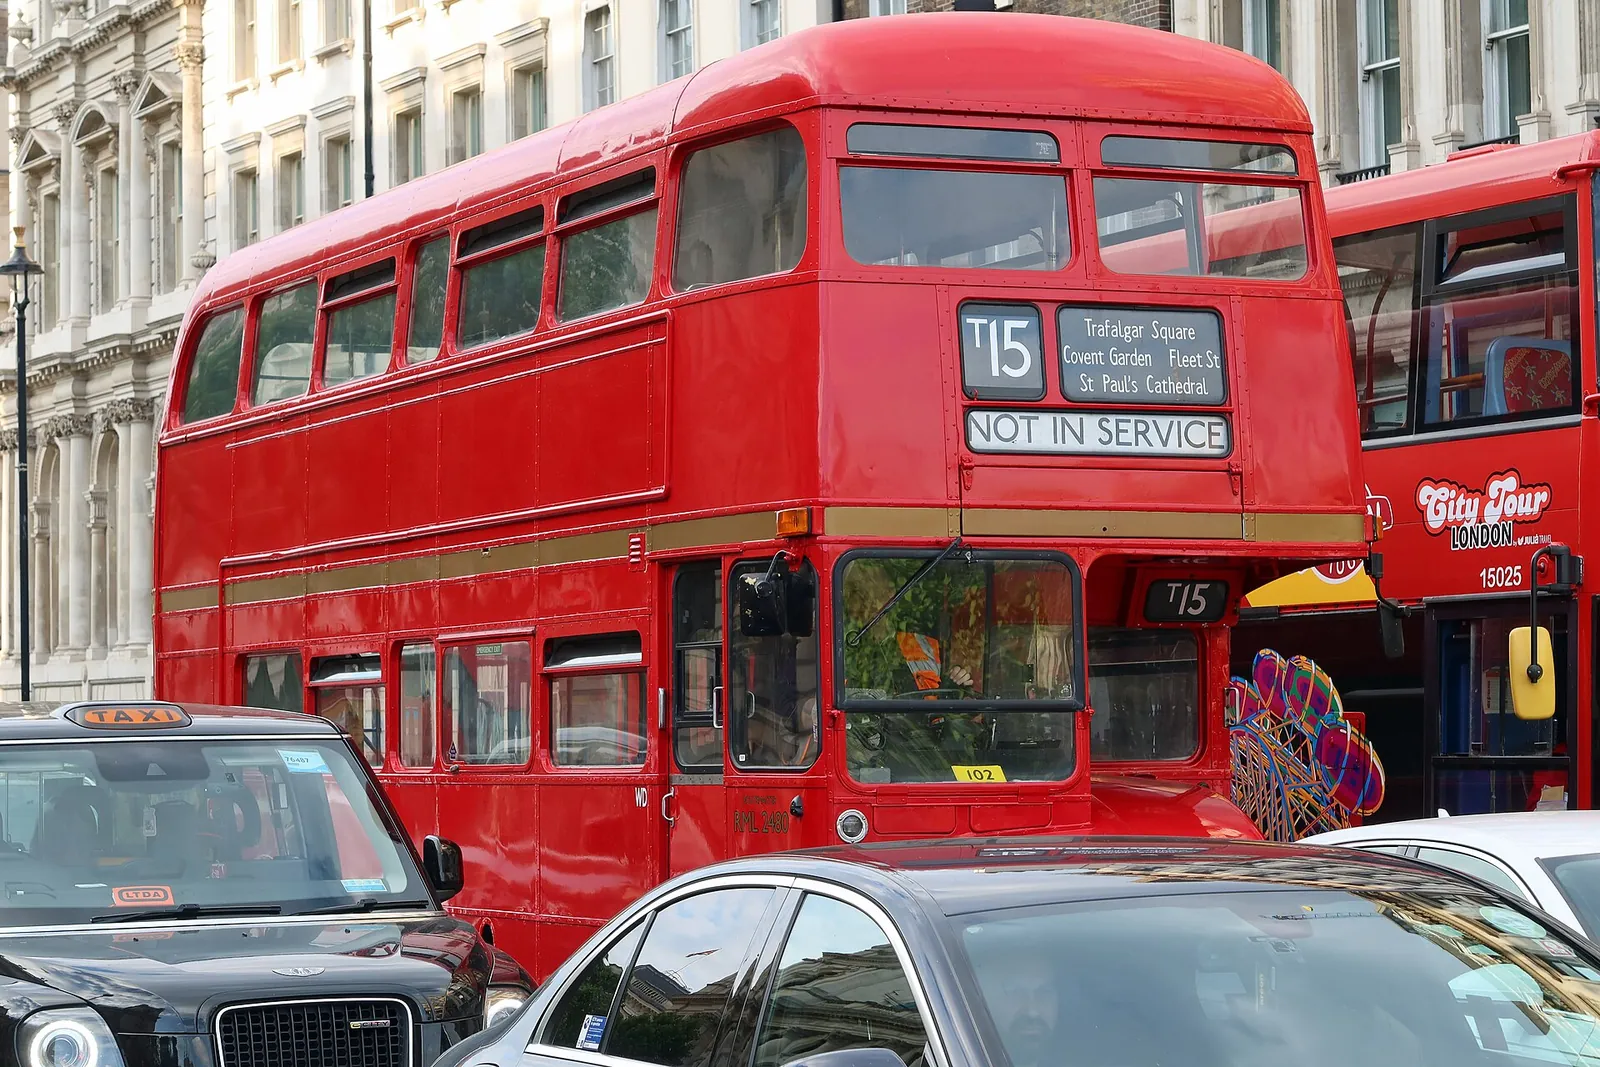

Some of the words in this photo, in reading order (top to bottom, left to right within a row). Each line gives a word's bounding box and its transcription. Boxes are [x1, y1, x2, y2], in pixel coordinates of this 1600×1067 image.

[1084, 318, 1144, 343] Trafalgar
[1151, 320, 1196, 345] Square
[966, 318, 1032, 378] T15
[1063, 345, 1105, 365] Covent
[1109, 347, 1152, 367] Garden
[1169, 349, 1203, 368] Fleet
[1205, 350, 1221, 369] St
[1079, 373, 1095, 392] St
[1103, 375, 1138, 394] Paul's
[1146, 375, 1209, 395] Cathedral
[969, 413, 1040, 443] NOT
[1053, 416, 1085, 445] IN
[1098, 417, 1226, 450] SERVICE
[1418, 485, 1480, 530] City
[1483, 476, 1549, 525] Tour
[1451, 521, 1513, 551] LONDON
[1479, 565, 1523, 588] 15025
[1167, 582, 1211, 616] T15
[91, 709, 175, 723] TAXI
[966, 769, 995, 780] 102
[634, 787, 648, 807] WD
[734, 811, 759, 833] RML
[761, 810, 790, 834] 2480
[125, 891, 162, 899] LTDA
